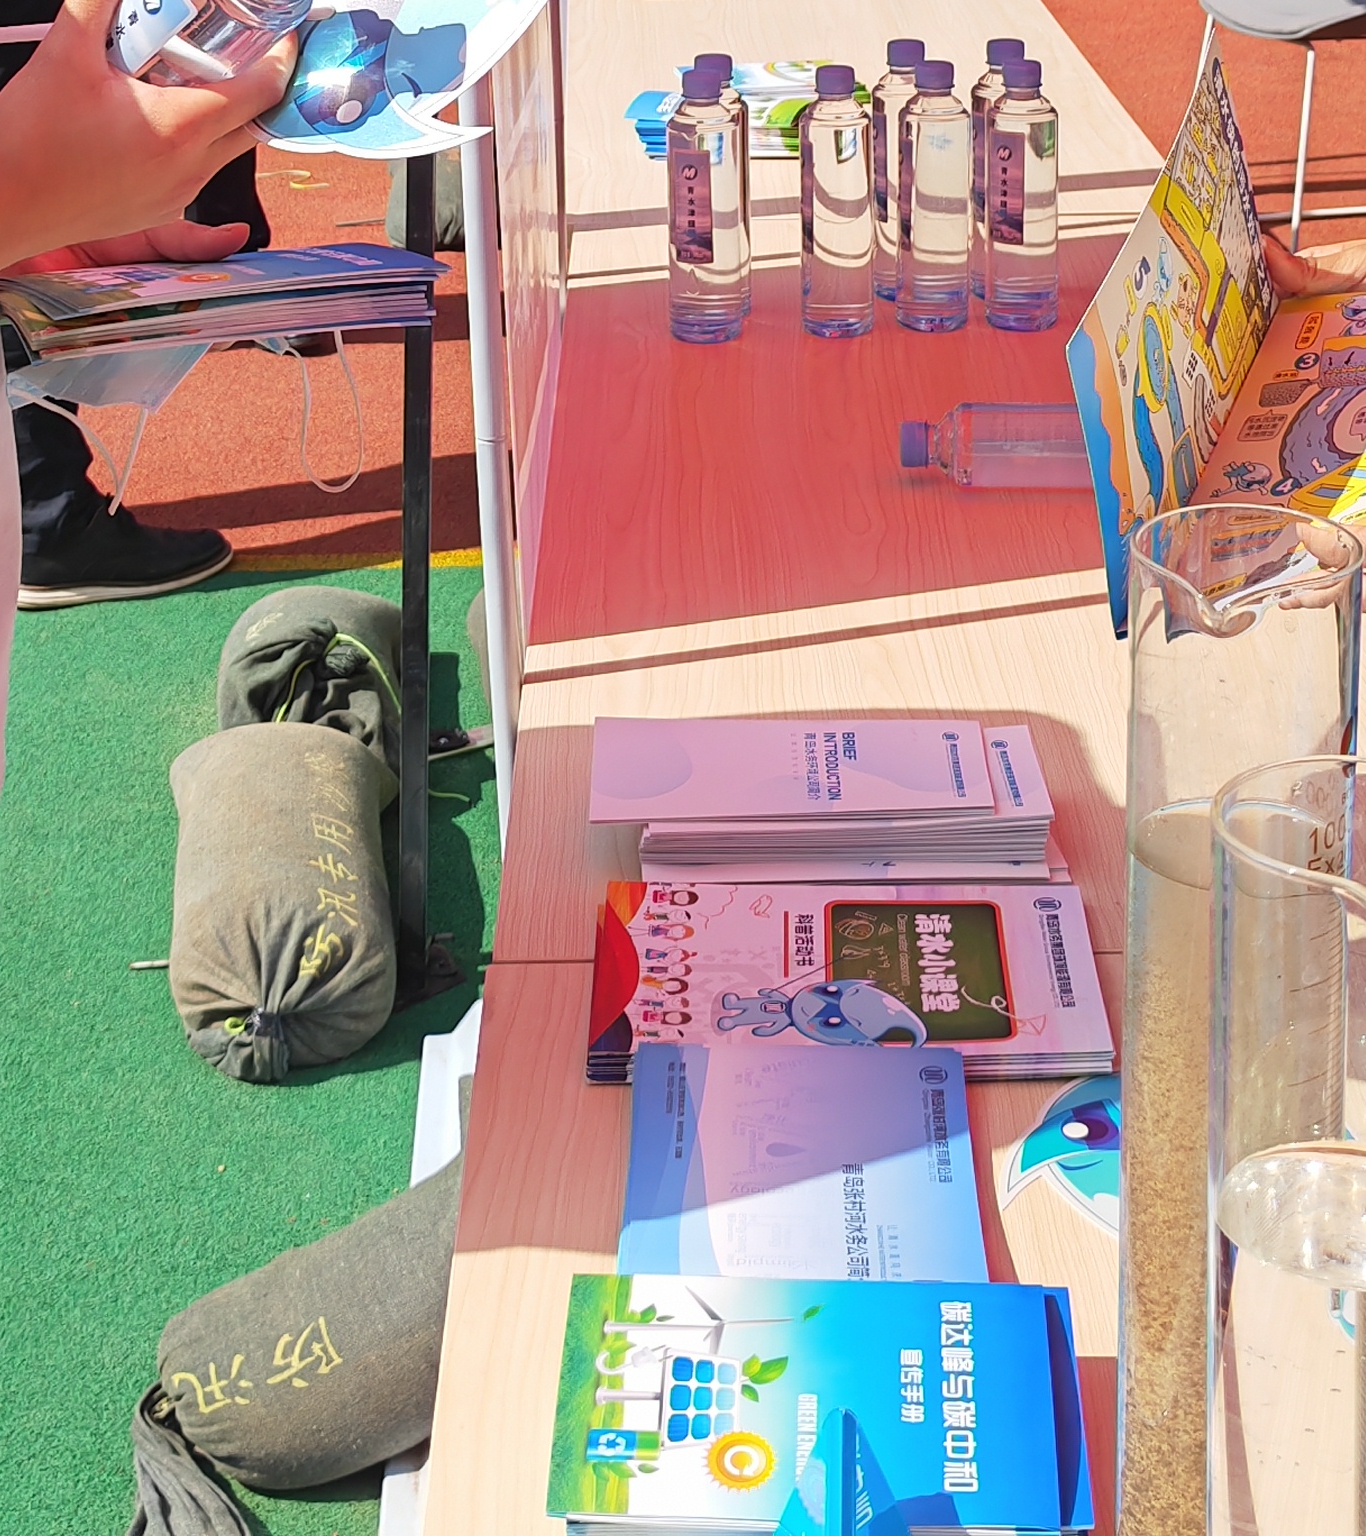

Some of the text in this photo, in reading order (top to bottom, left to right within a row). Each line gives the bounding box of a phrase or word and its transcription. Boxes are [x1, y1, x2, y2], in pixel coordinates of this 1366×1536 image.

[1299, 354, 1315, 368] 3
[823, 731, 842, 801] INTRODUCTION
[842, 731, 858, 761] BRIEF
[915, 913, 963, 1014] 清水小课堂
[842, 1163, 870, 1280] 青岛张村河水务公司简
[171, 1315, 343, 1414] 防汛
[899, 1348, 925, 1424] 宣传手册
[938, 1300, 980, 1493] 碳达峰与碳中和
[797, 1394, 819, 1432] GREEN
